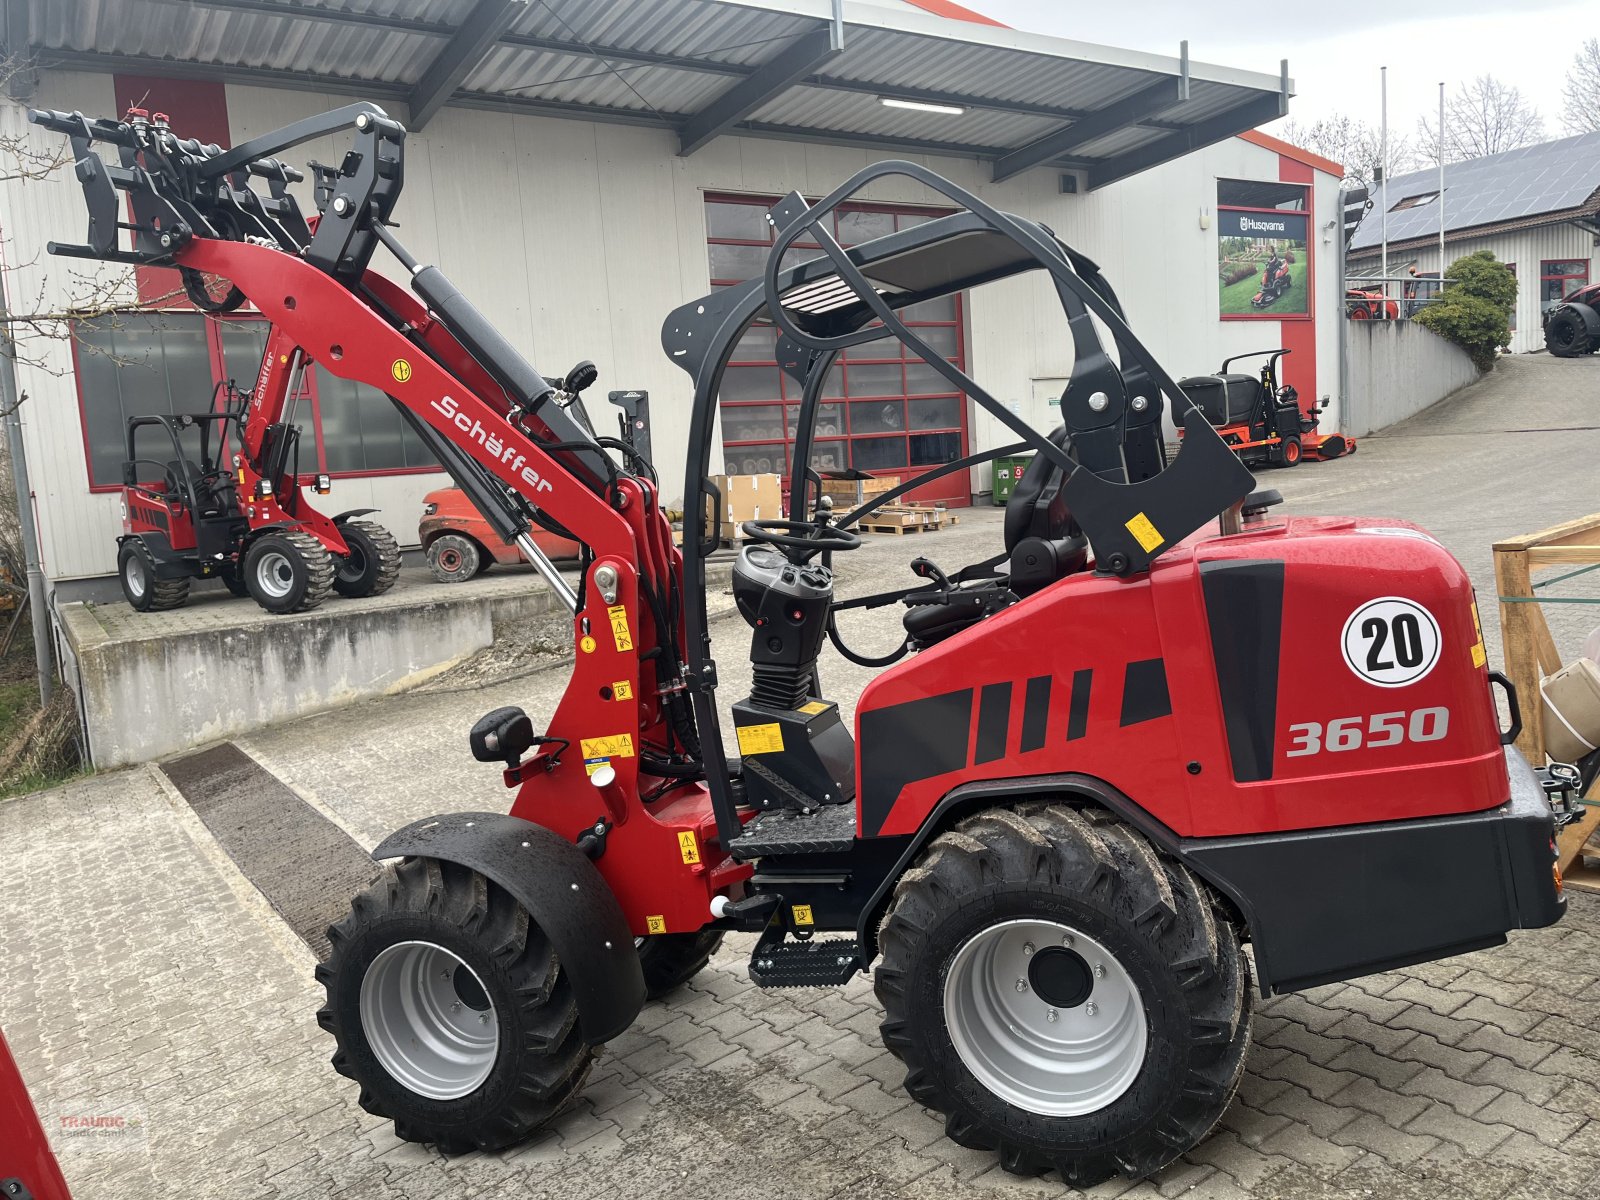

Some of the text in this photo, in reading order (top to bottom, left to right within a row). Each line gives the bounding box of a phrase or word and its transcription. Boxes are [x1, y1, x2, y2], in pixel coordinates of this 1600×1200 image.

[1248, 219, 1285, 231] Husqvarna
[254, 352, 274, 411] Schäffer
[430, 395, 553, 492] Schäffer
[1361, 613, 1423, 671] 20
[1286, 706, 1450, 757] 3650
